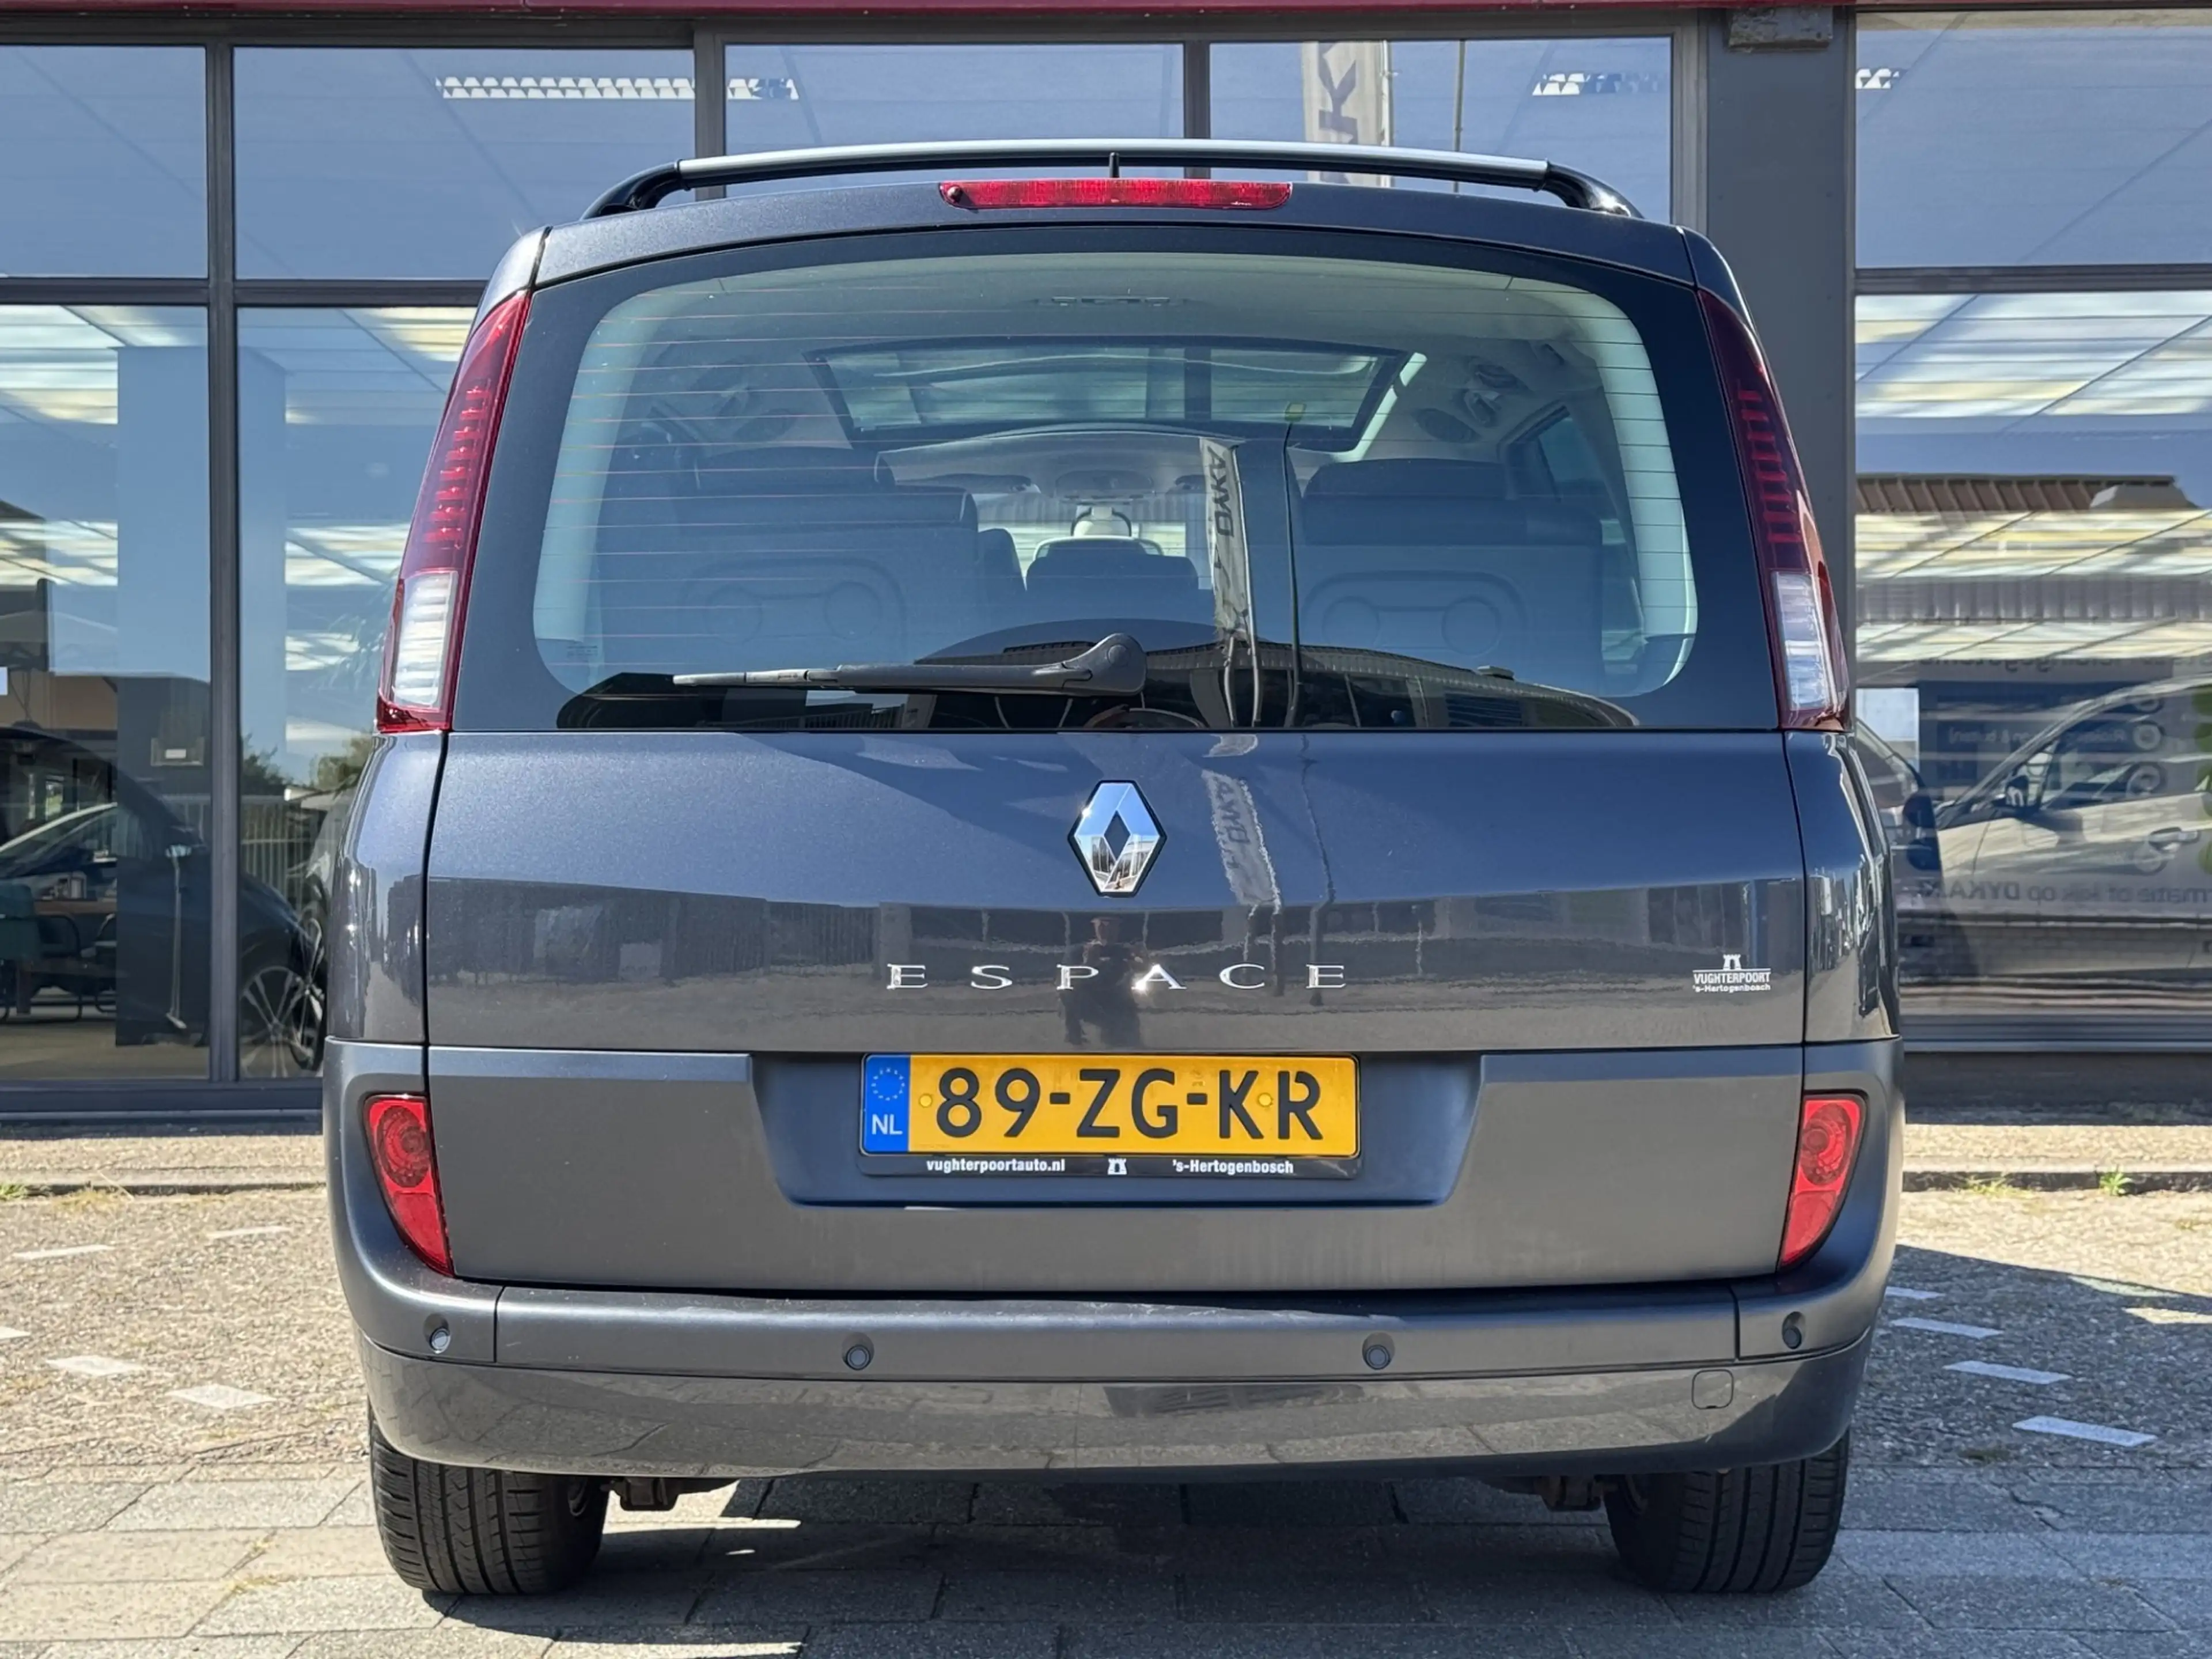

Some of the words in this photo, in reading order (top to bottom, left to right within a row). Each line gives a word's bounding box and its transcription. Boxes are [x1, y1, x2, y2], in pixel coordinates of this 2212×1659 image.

[886, 963, 1347, 990] ESPACE
[1694, 972, 1771, 984] VUGHTERPOORT
[936, 1067, 1323, 1141] 89-ZG-KR
[872, 1113, 903, 1135] NL
[926, 1158, 1065, 1173] vughterpoortauto.nl
[1172, 1159, 1294, 1175] 's-Hertogenbosch
